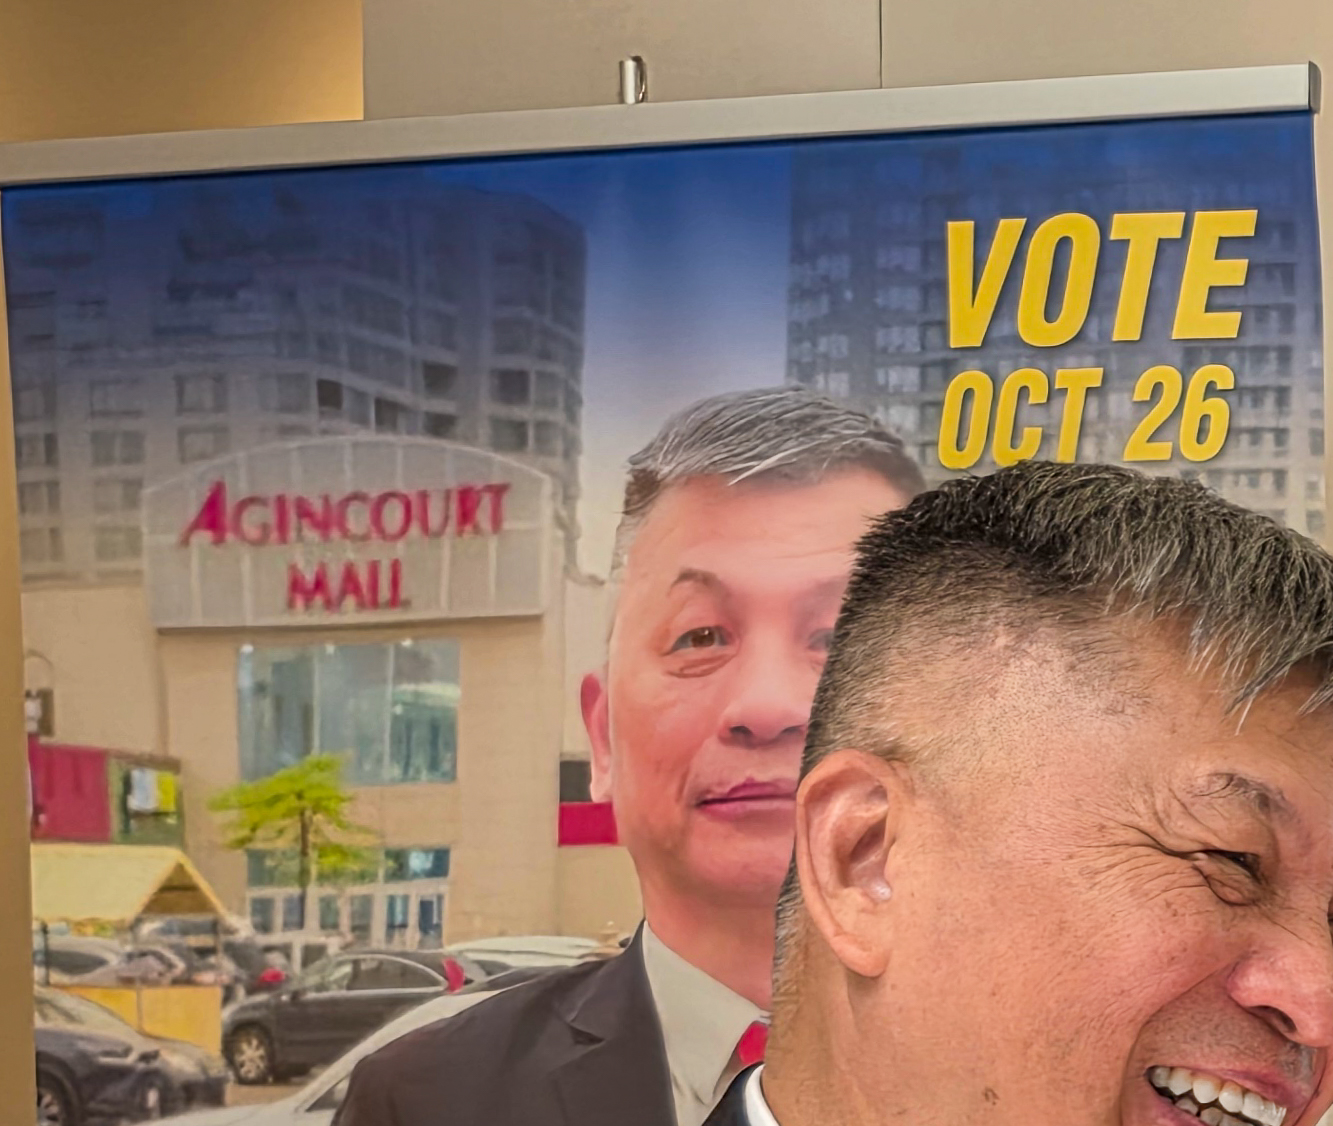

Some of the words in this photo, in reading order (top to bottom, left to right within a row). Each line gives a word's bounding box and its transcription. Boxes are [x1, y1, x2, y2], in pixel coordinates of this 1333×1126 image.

[947, 209, 1259, 349] VOTE
[938, 367, 1105, 470] OCT
[1123, 363, 1236, 463] 26
[179, 480, 512, 548] AGINCOURT
[286, 557, 412, 614] MALL
